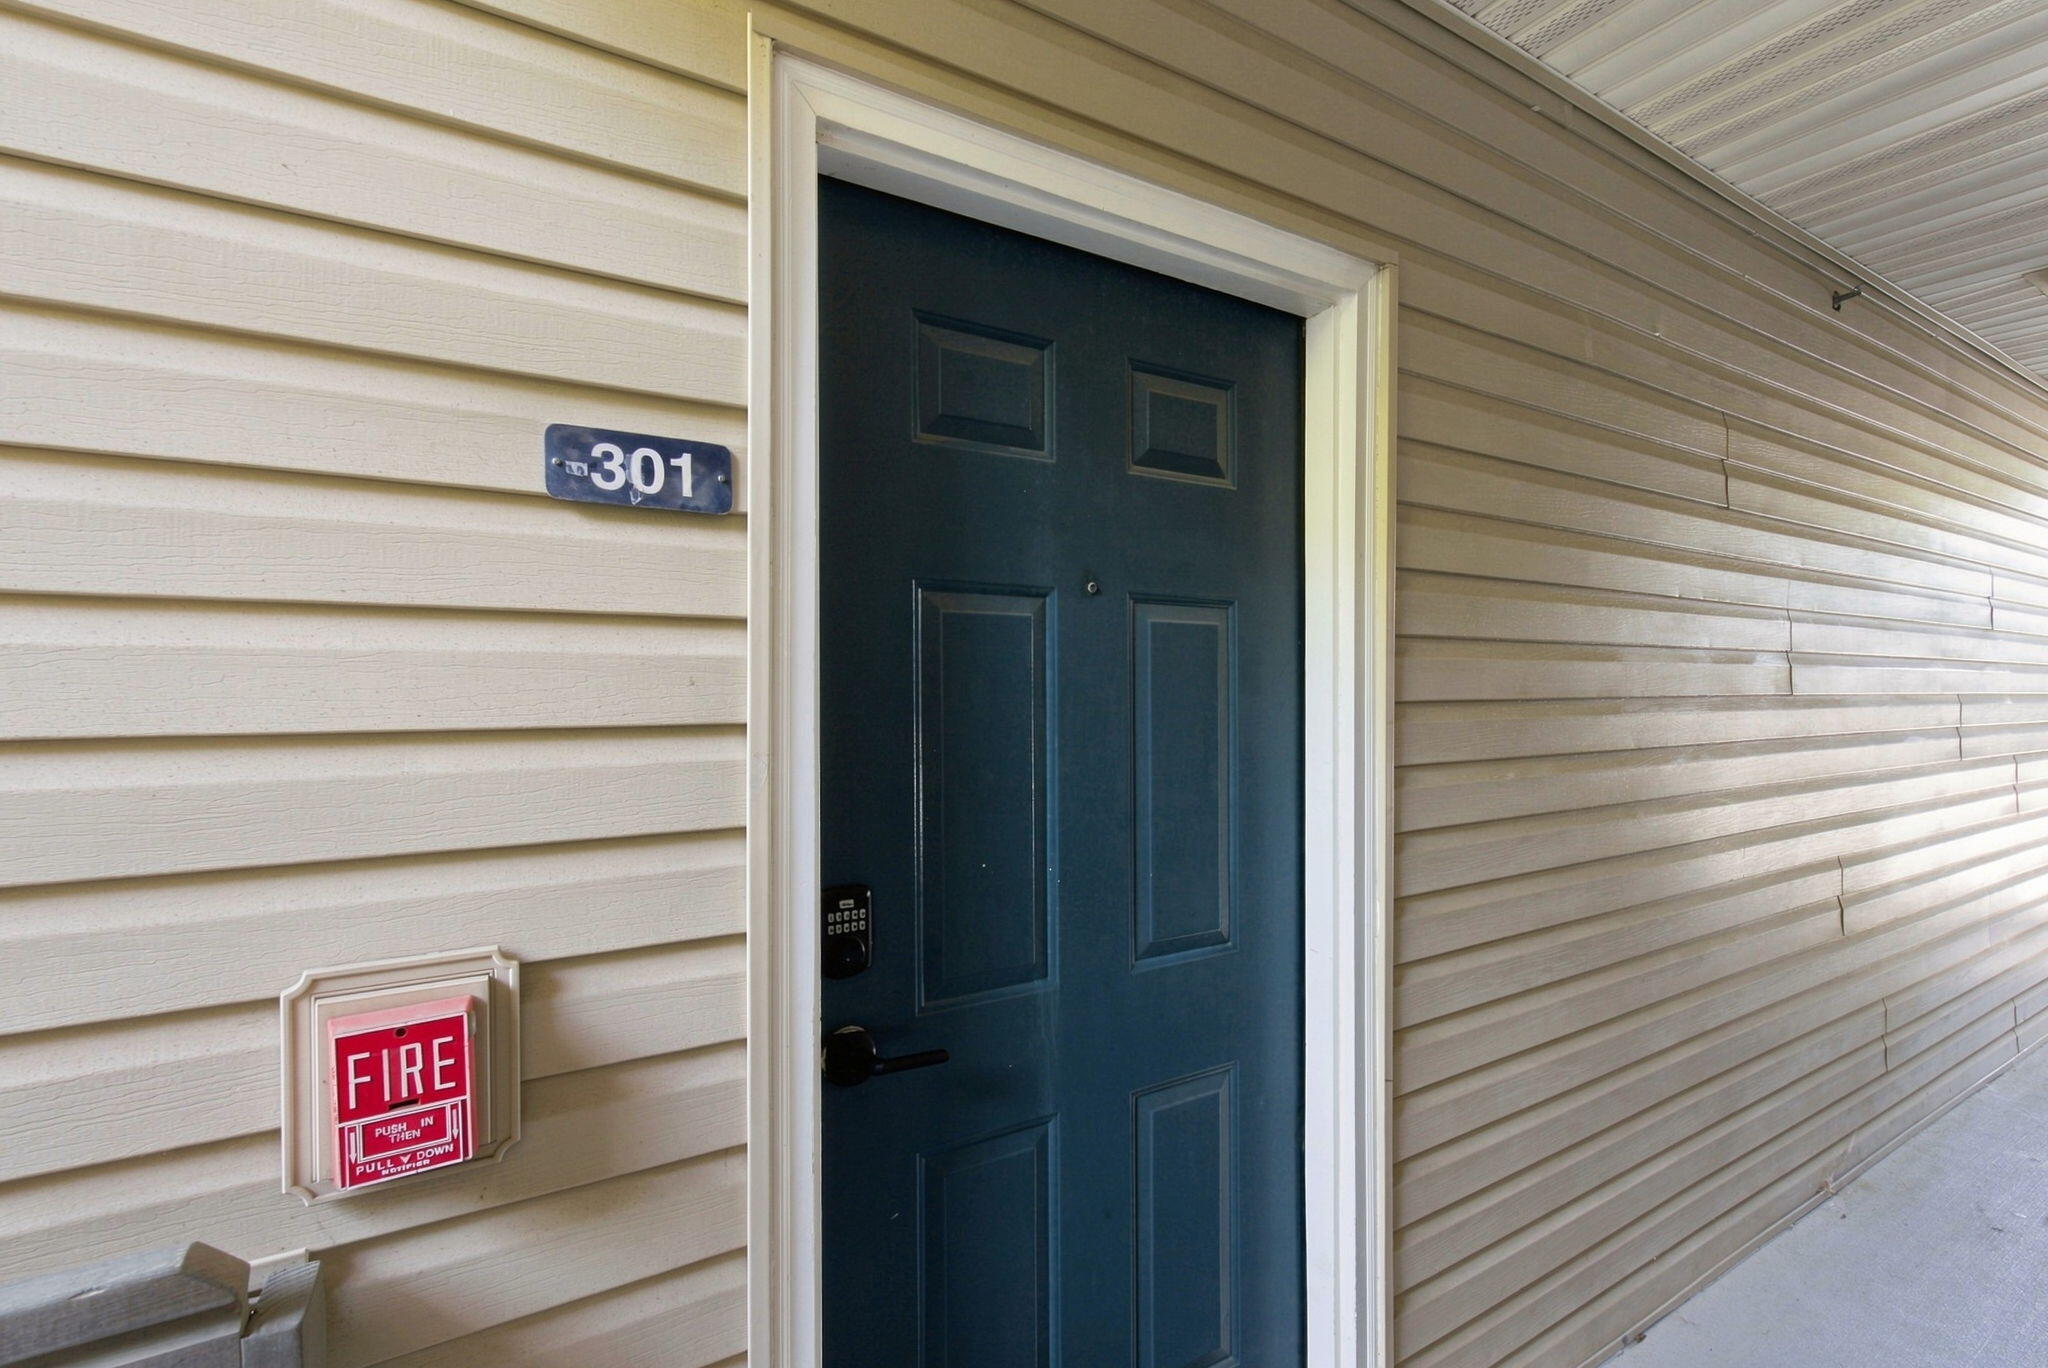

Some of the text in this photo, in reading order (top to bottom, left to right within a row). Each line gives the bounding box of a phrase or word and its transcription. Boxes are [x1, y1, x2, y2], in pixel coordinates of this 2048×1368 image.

[590, 443, 693, 498] 301
[347, 1036, 456, 1110] FIRE
[375, 1115, 434, 1138] PUSH IN
[389, 1129, 421, 1144] THEN
[356, 1143, 454, 1176] PULL DOWN
[381, 1159, 430, 1176] NOTIFIER
